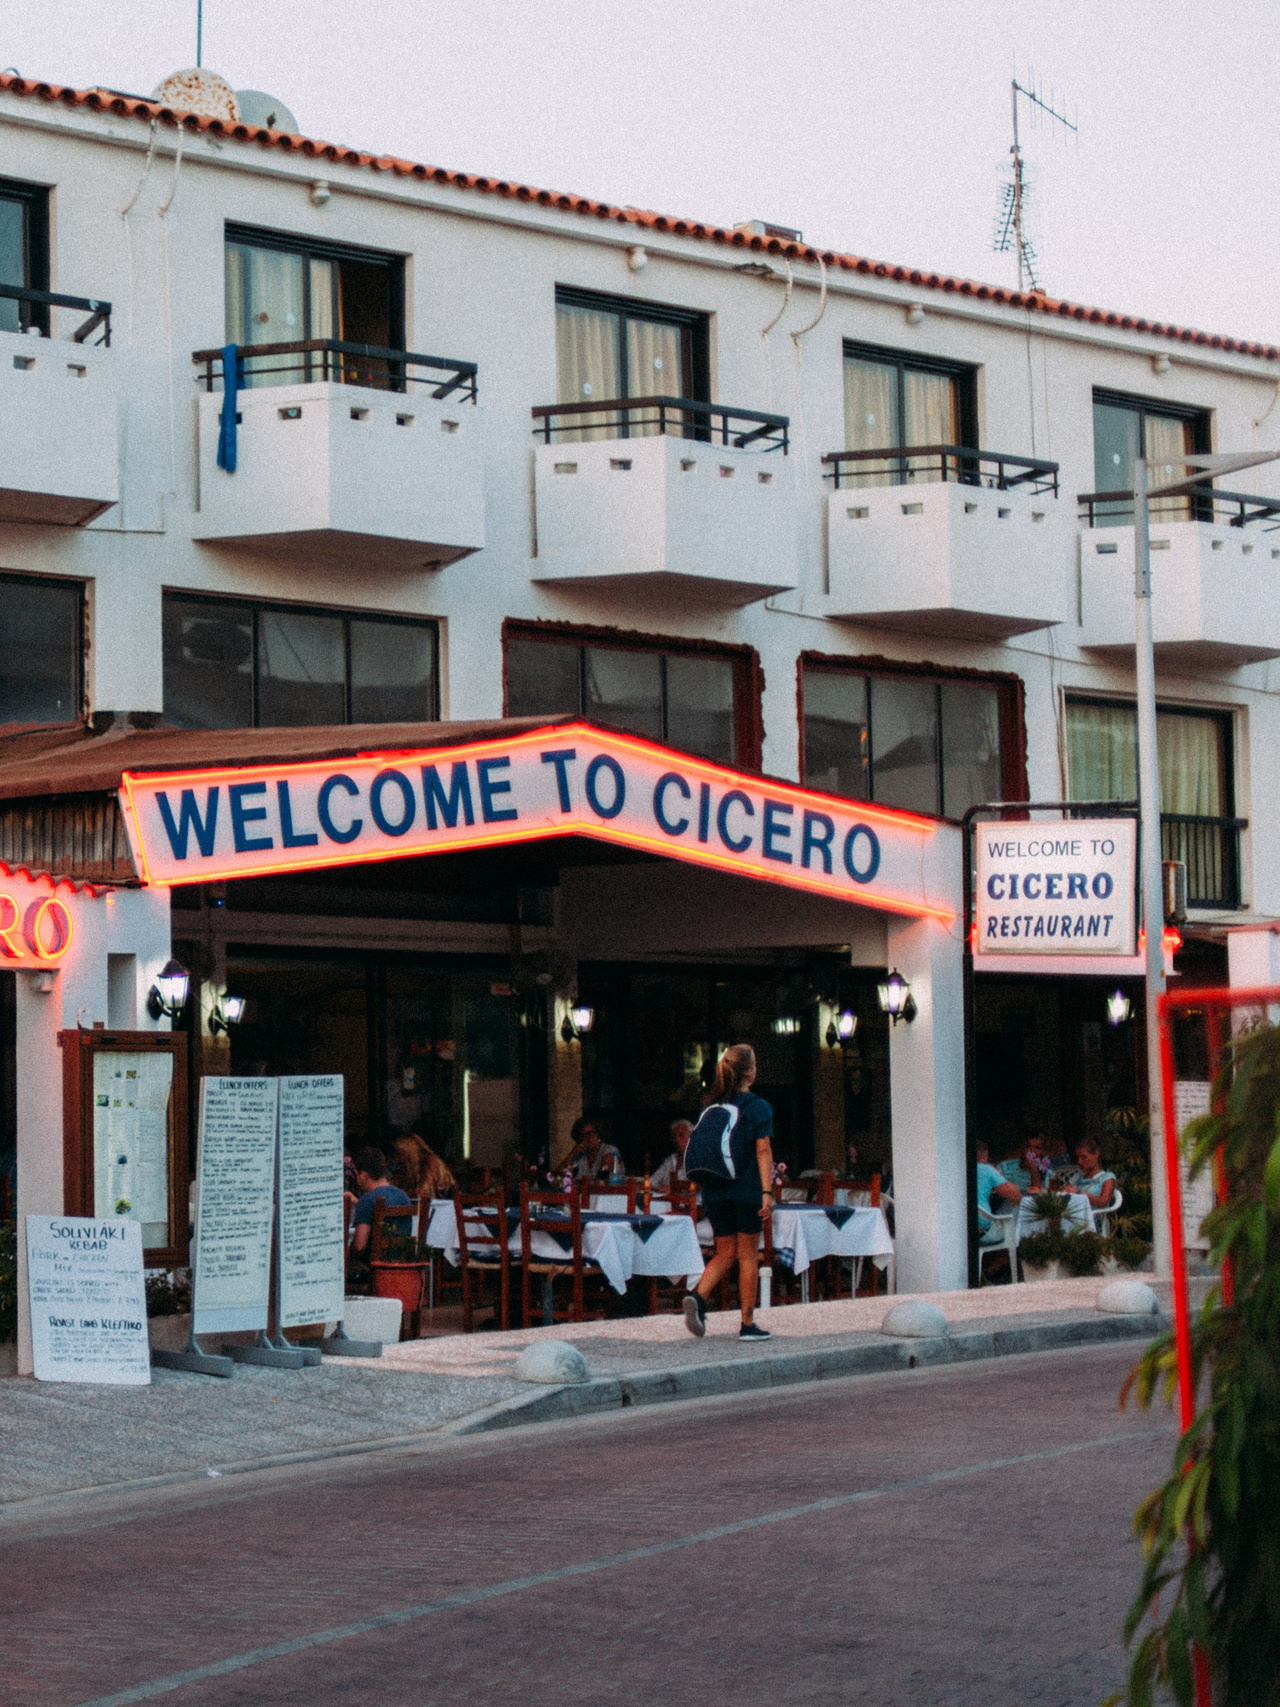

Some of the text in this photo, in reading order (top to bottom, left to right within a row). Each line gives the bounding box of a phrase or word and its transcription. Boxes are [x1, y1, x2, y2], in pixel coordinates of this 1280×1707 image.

[155, 748, 882, 884] WELCOME TO CICERO
[988, 839, 1115, 858] WELCOME TO
[986, 871, 1114, 900] CICERO
[986, 914, 1114, 939] RESTAURANT
